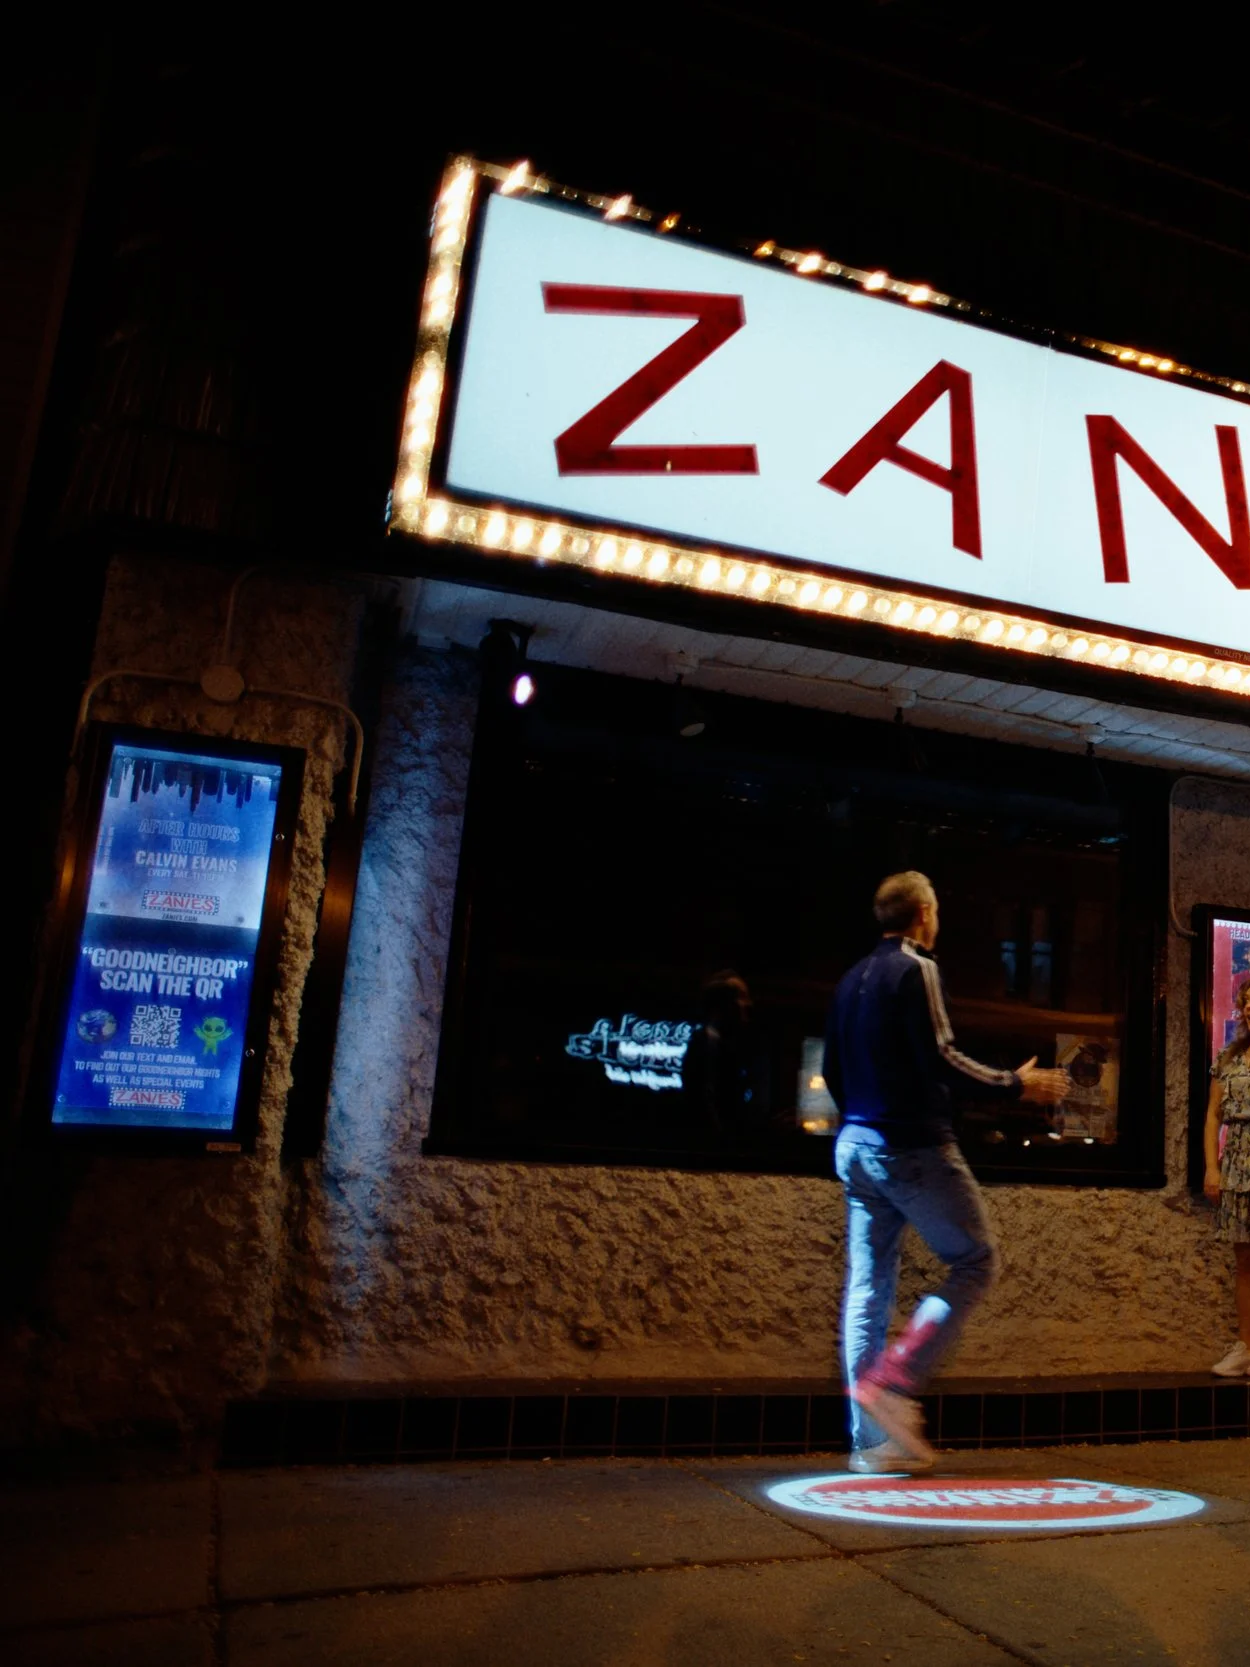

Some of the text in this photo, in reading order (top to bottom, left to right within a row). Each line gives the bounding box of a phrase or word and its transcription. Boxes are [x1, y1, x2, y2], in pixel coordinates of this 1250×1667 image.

[138, 818, 240, 843] AFTER HOURS
[135, 850, 238, 873] CALVIN EVANS
[148, 893, 214, 912] ZANIES
[100, 968, 223, 999] SCAN THE QR
[101, 1050, 118, 1060] JOIN
[119, 1051, 135, 1062] OUR
[136, 1052, 156, 1063] TEXT
[157, 1053, 173, 1063] AND
[75, 1060, 85, 1070] TO
[86, 1061, 104, 1071] FIND
[104, 1062, 121, 1072] OUT
[121, 1063, 137, 1073] OUR
[93, 1074, 204, 1089] AS WELL AS SPECIAL EVENTS
[116, 1090, 181, 1106] ZANIES
